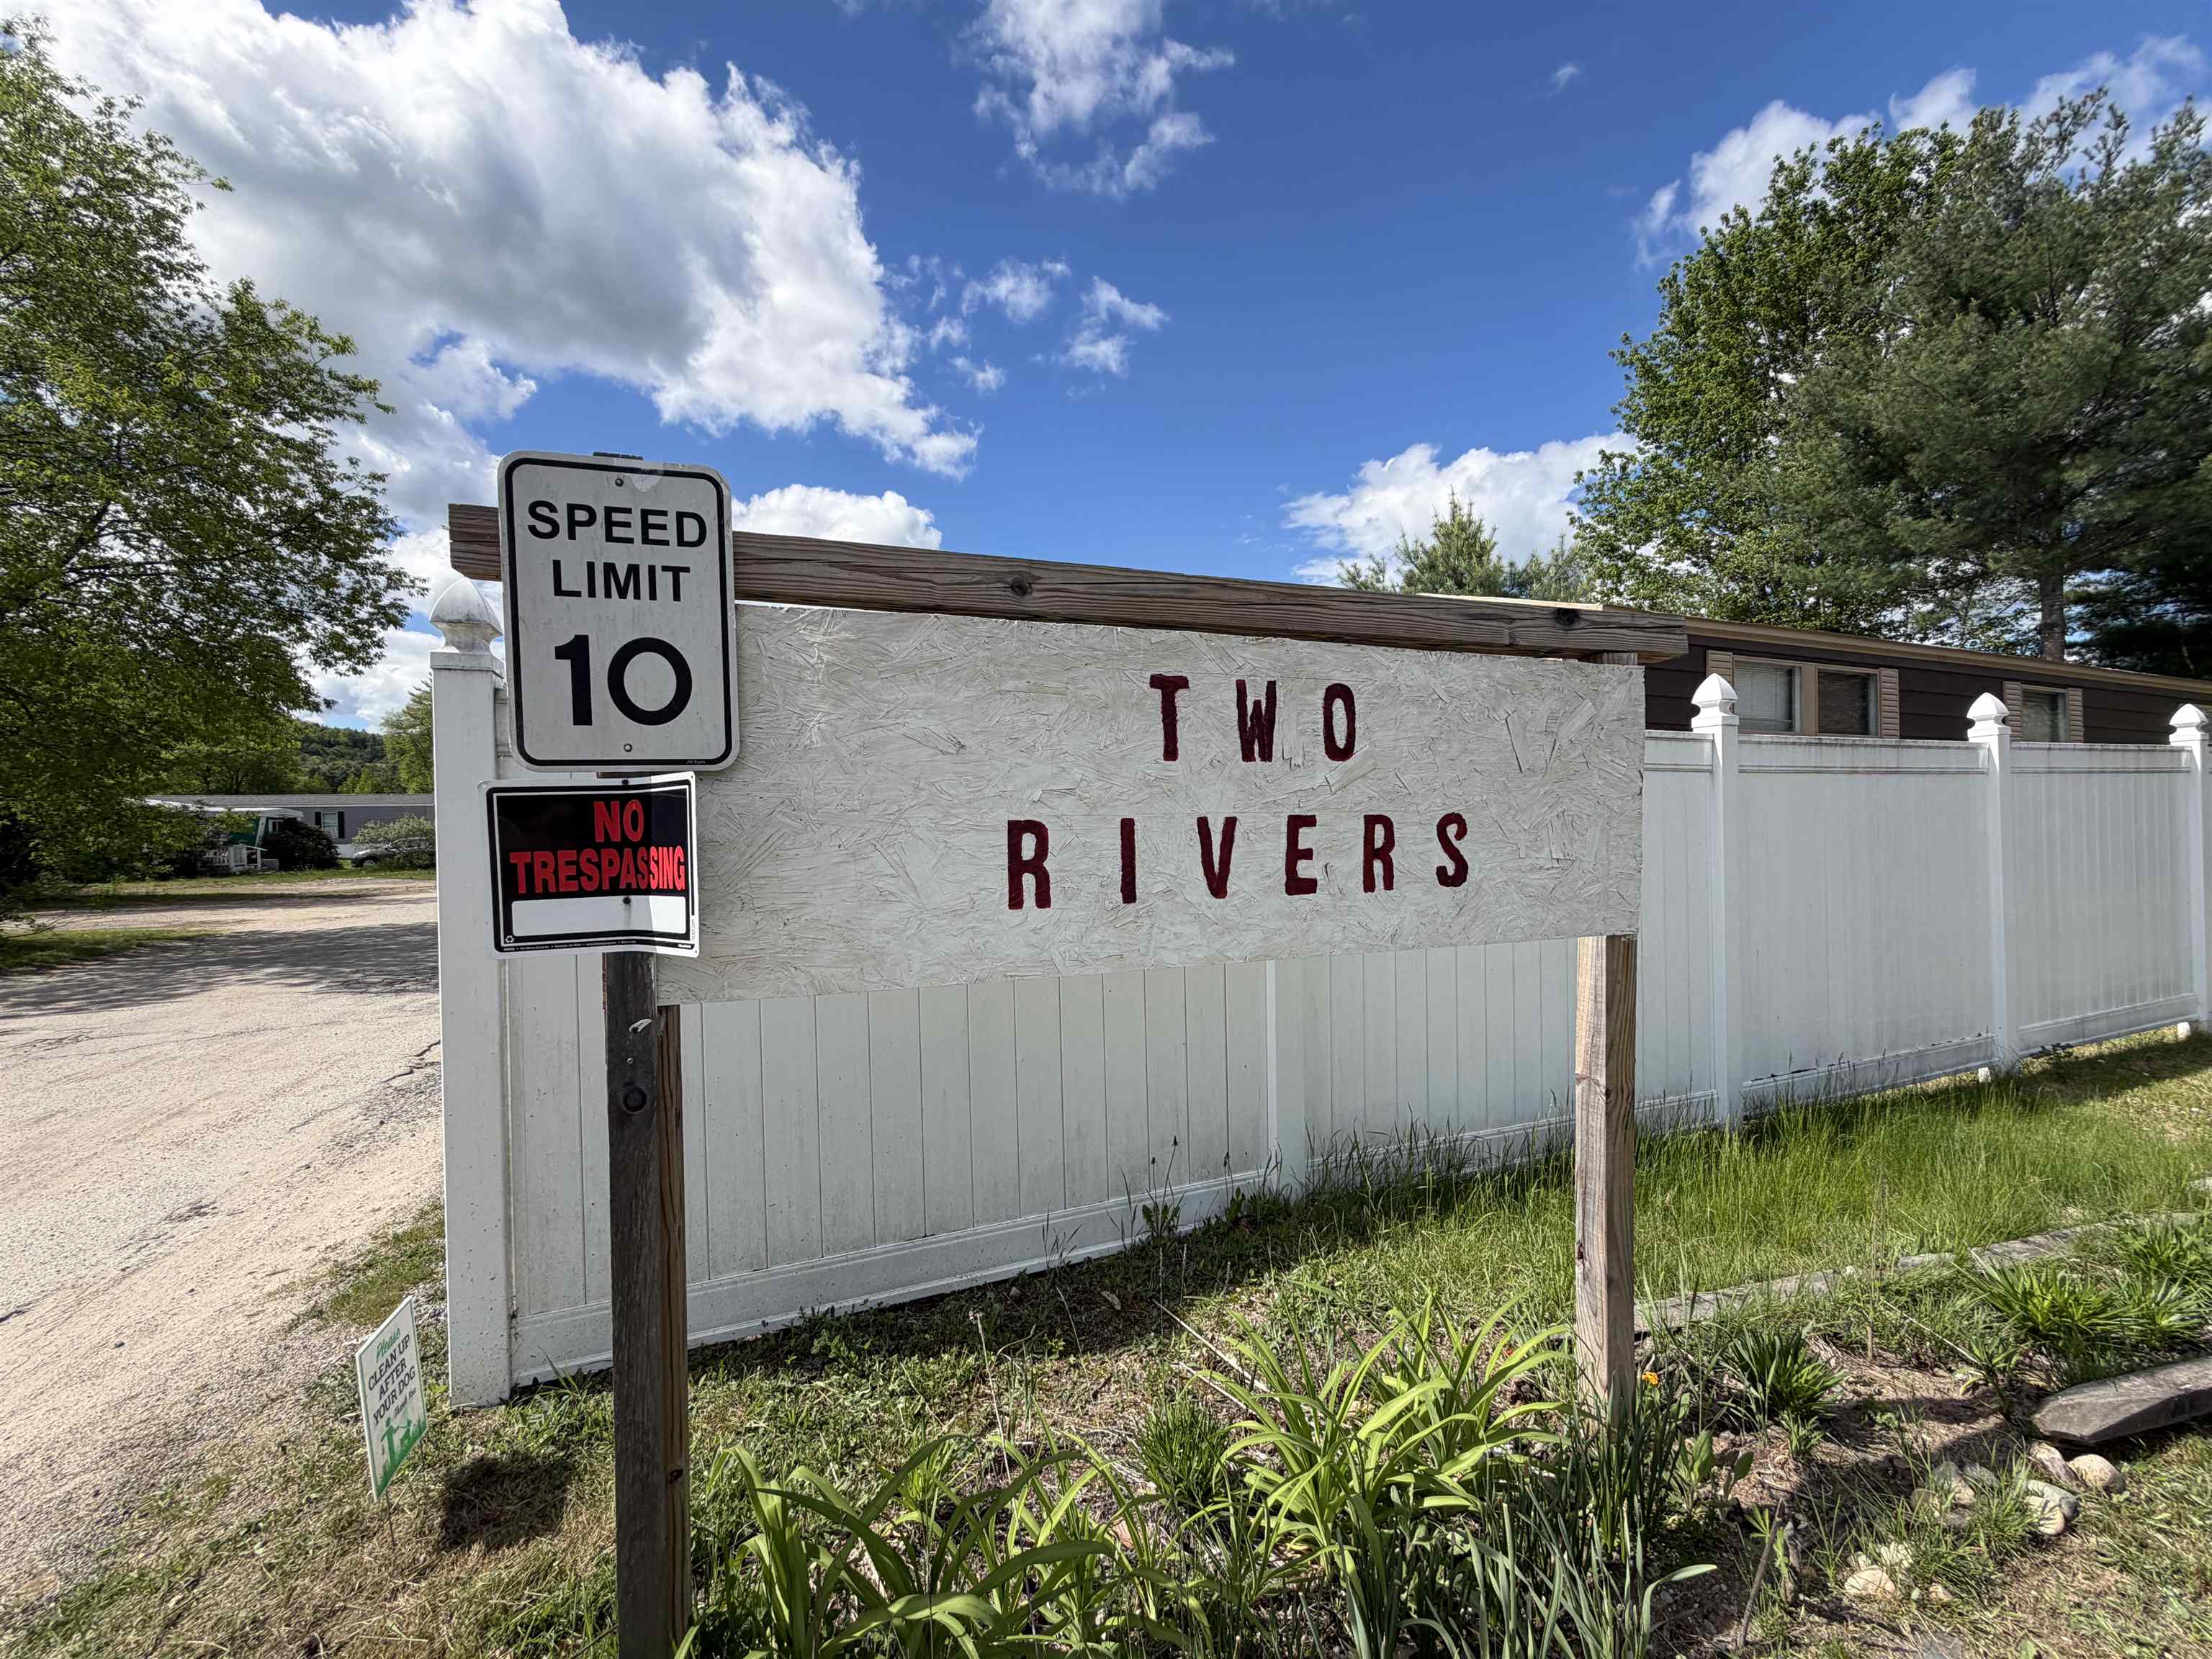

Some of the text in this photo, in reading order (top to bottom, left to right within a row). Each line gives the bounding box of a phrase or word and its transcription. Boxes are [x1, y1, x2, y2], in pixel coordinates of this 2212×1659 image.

[527, 500, 707, 548] SPEED
[552, 559, 691, 602] LIMIT
[554, 634, 693, 726] 10
[1149, 673, 1356, 762] TWO
[593, 799, 644, 842] NO
[509, 845, 686, 894] TRESPASSING
[1007, 811, 1468, 910] RIVERS
[368, 1334, 410, 1390] CLEAN UP
[379, 1357, 407, 1401] AFTER
[373, 1388, 397, 1426] YOUR
[398, 1365, 415, 1395] DOG
